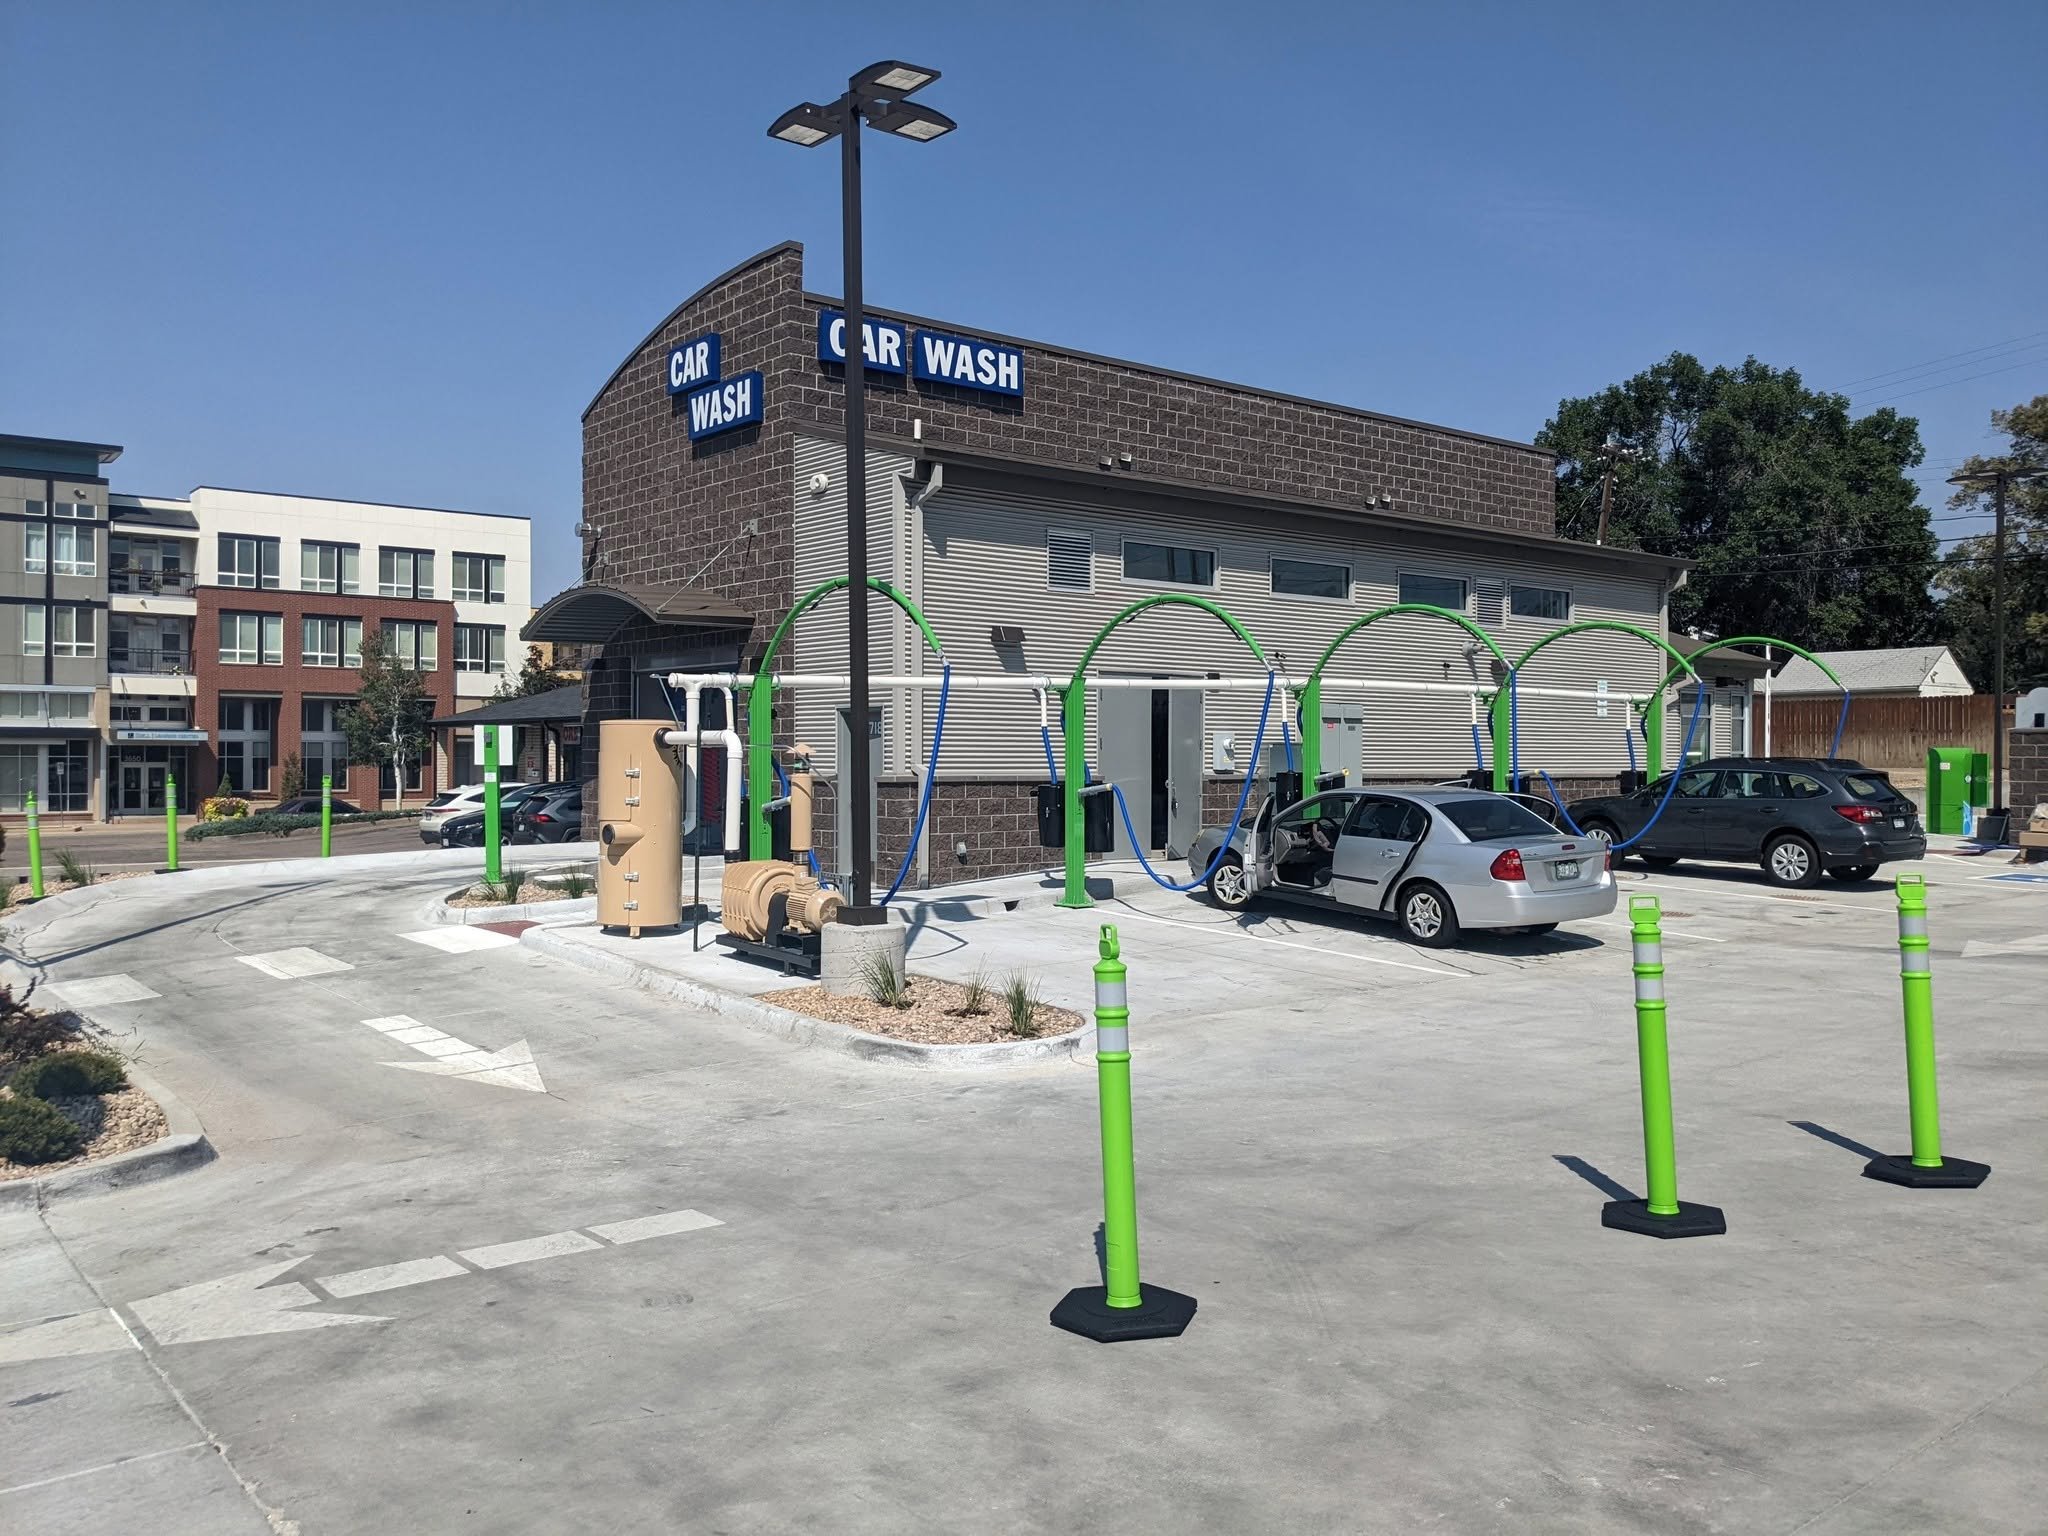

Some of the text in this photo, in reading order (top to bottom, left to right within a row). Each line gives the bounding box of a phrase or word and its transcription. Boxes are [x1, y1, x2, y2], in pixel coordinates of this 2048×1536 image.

[671, 342, 708, 387] CAR
[830, 318, 1018, 390] CAR WASH
[691, 378, 751, 433] WASH
